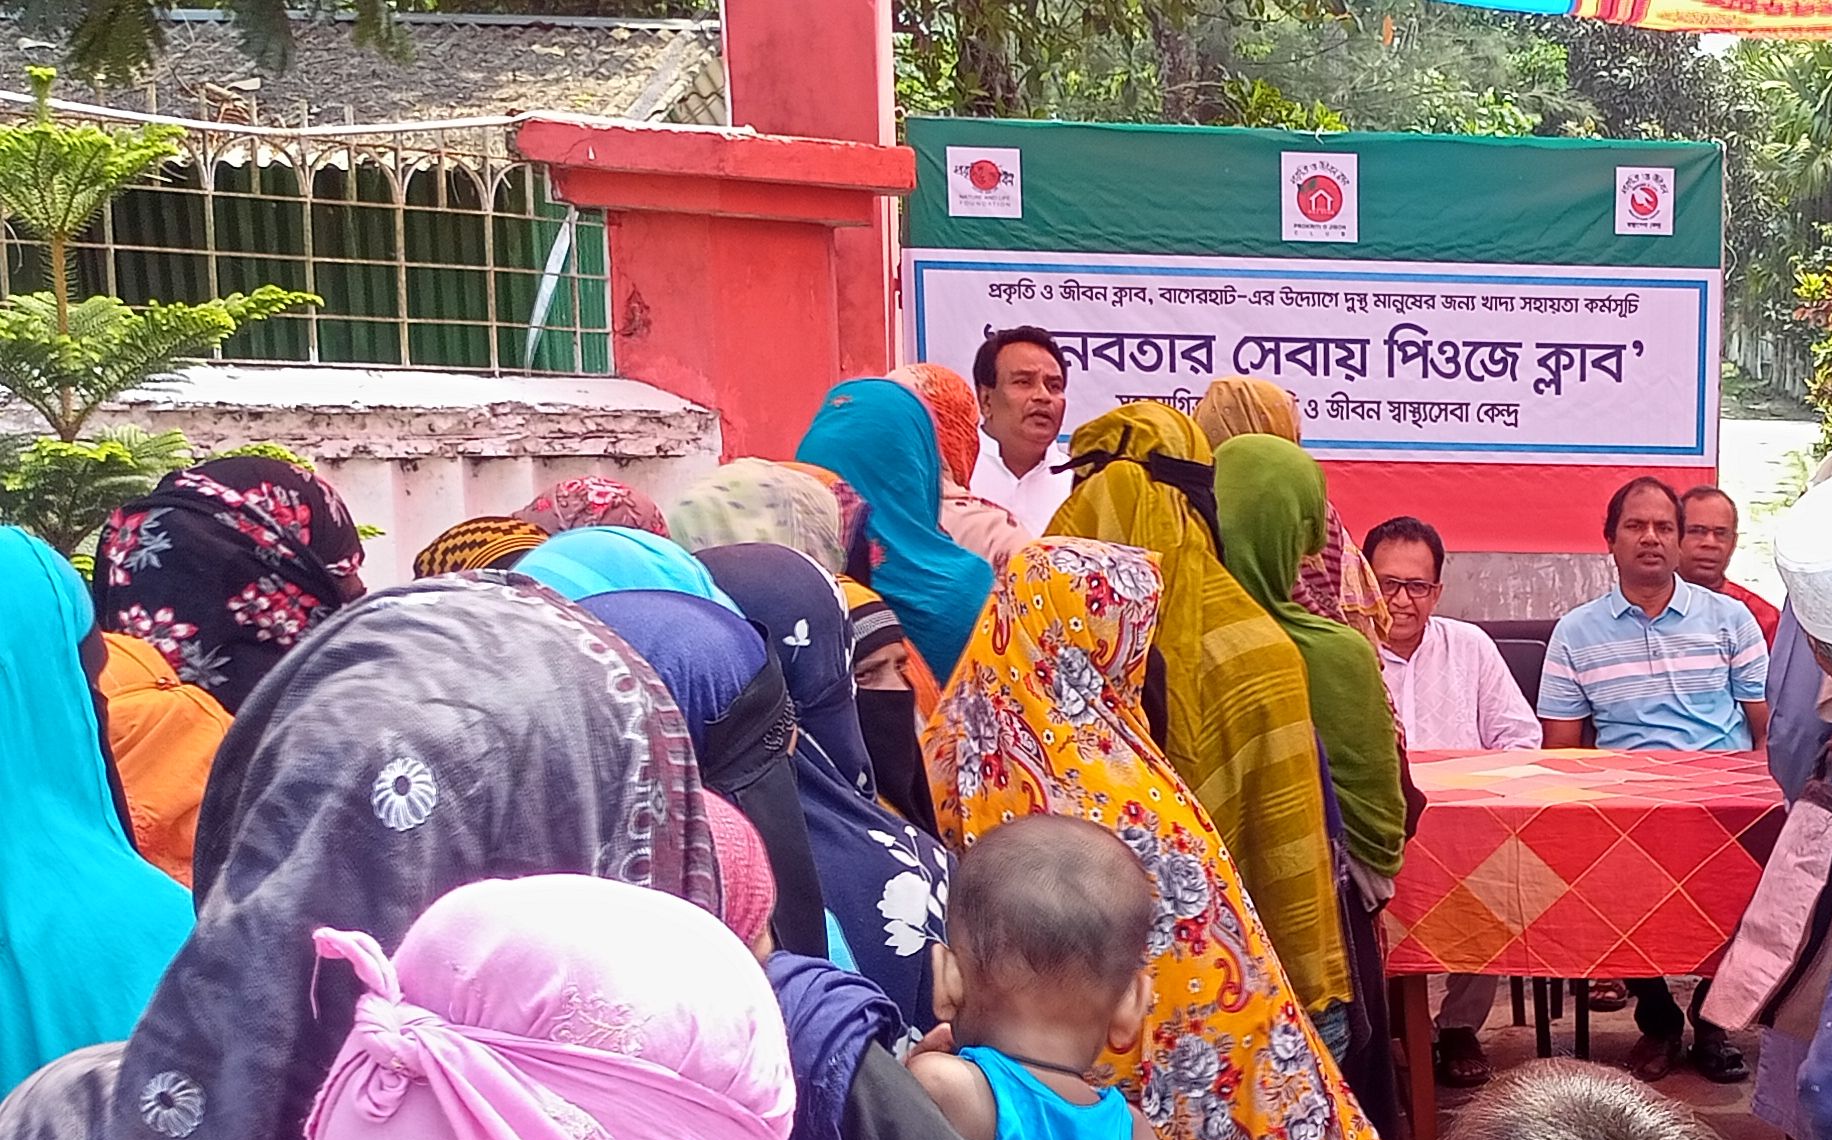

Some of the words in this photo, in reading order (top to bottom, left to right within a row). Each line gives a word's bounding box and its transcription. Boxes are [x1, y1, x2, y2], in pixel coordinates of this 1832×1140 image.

[988, 278, 1036, 304] প্রকৃতি
[1040, 285, 1054, 300] ও
[1059, 279, 1108, 302] জীবন
[1112, 287, 1153, 307] ক্লাব,
[1280, 286, 1339, 308] উদ্যোগে
[1344, 293, 1369, 314] দুস্থ
[1373, 293, 1436, 314] মানুষের
[1441, 295, 1476, 312] জন্য
[1481, 295, 1515, 312] খাদ্য
[1519, 297, 1579, 315] সহায়তা
[1584, 293, 1640, 318] কর্মসূচি
[1232, 335, 1371, 383] সেবায়
[1384, 323, 1522, 382] পিওজে
[1304, 400, 1319, 419] ও
[1326, 391, 1382, 421] জীবন
[1387, 401, 1470, 429] স্বাস্থ্যসেবা
[1476, 402, 1520, 428] কেন্দ্র
